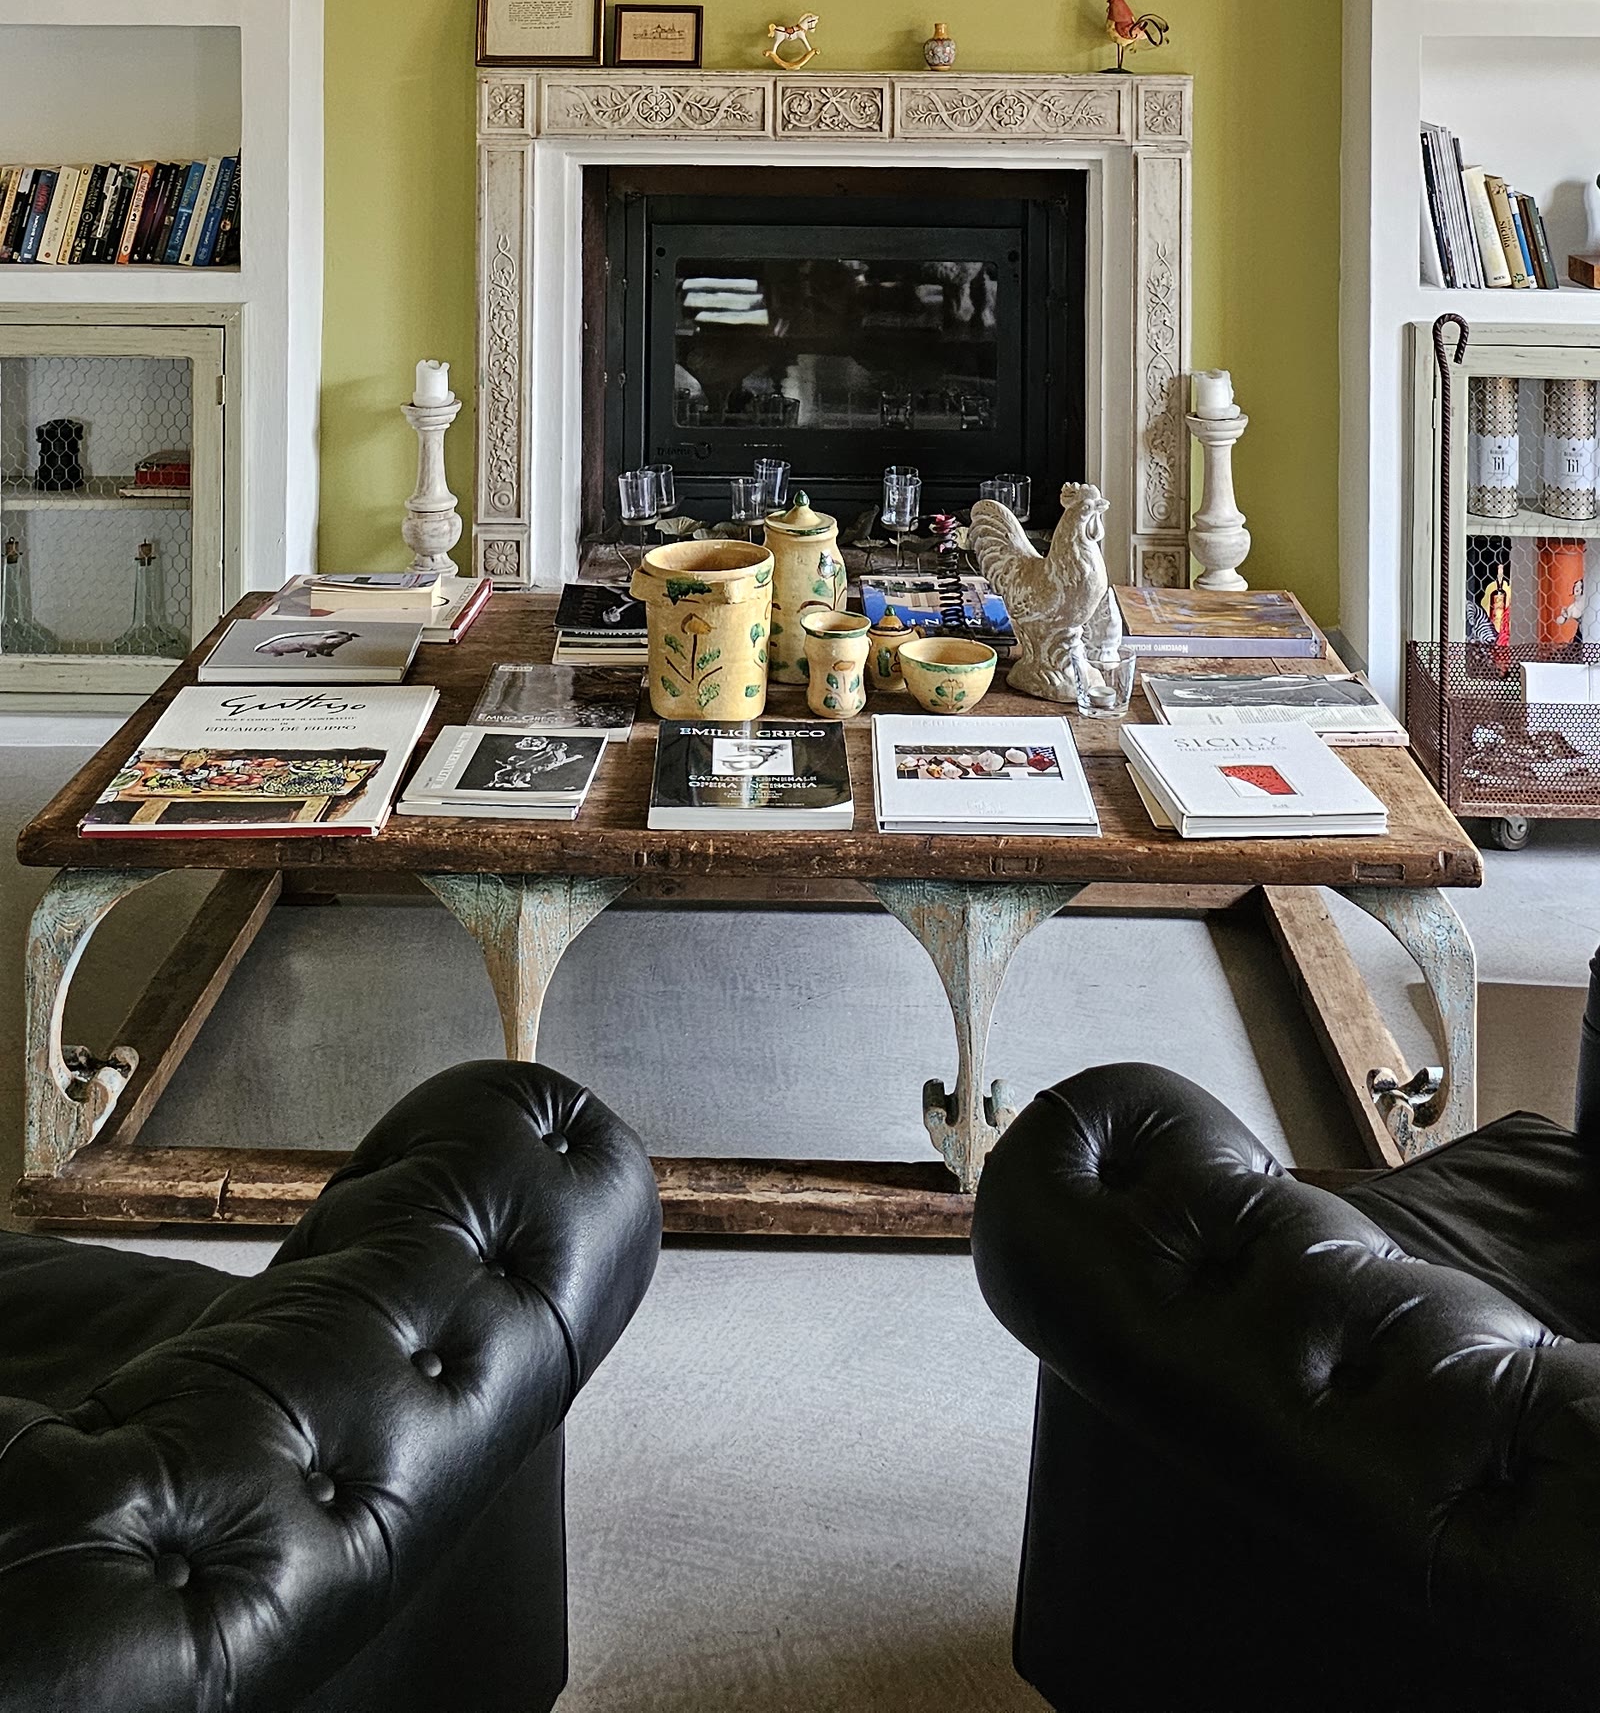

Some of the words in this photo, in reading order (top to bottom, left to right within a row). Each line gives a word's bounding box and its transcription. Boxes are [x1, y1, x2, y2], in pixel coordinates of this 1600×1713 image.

[30, 214, 40, 236] BROWN
[1497, 219, 1512, 248] Sicilia
[679, 727, 750, 737] EMILIO
[755, 728, 826, 738] GRECO
[1173, 736, 1279, 747] SICILY
